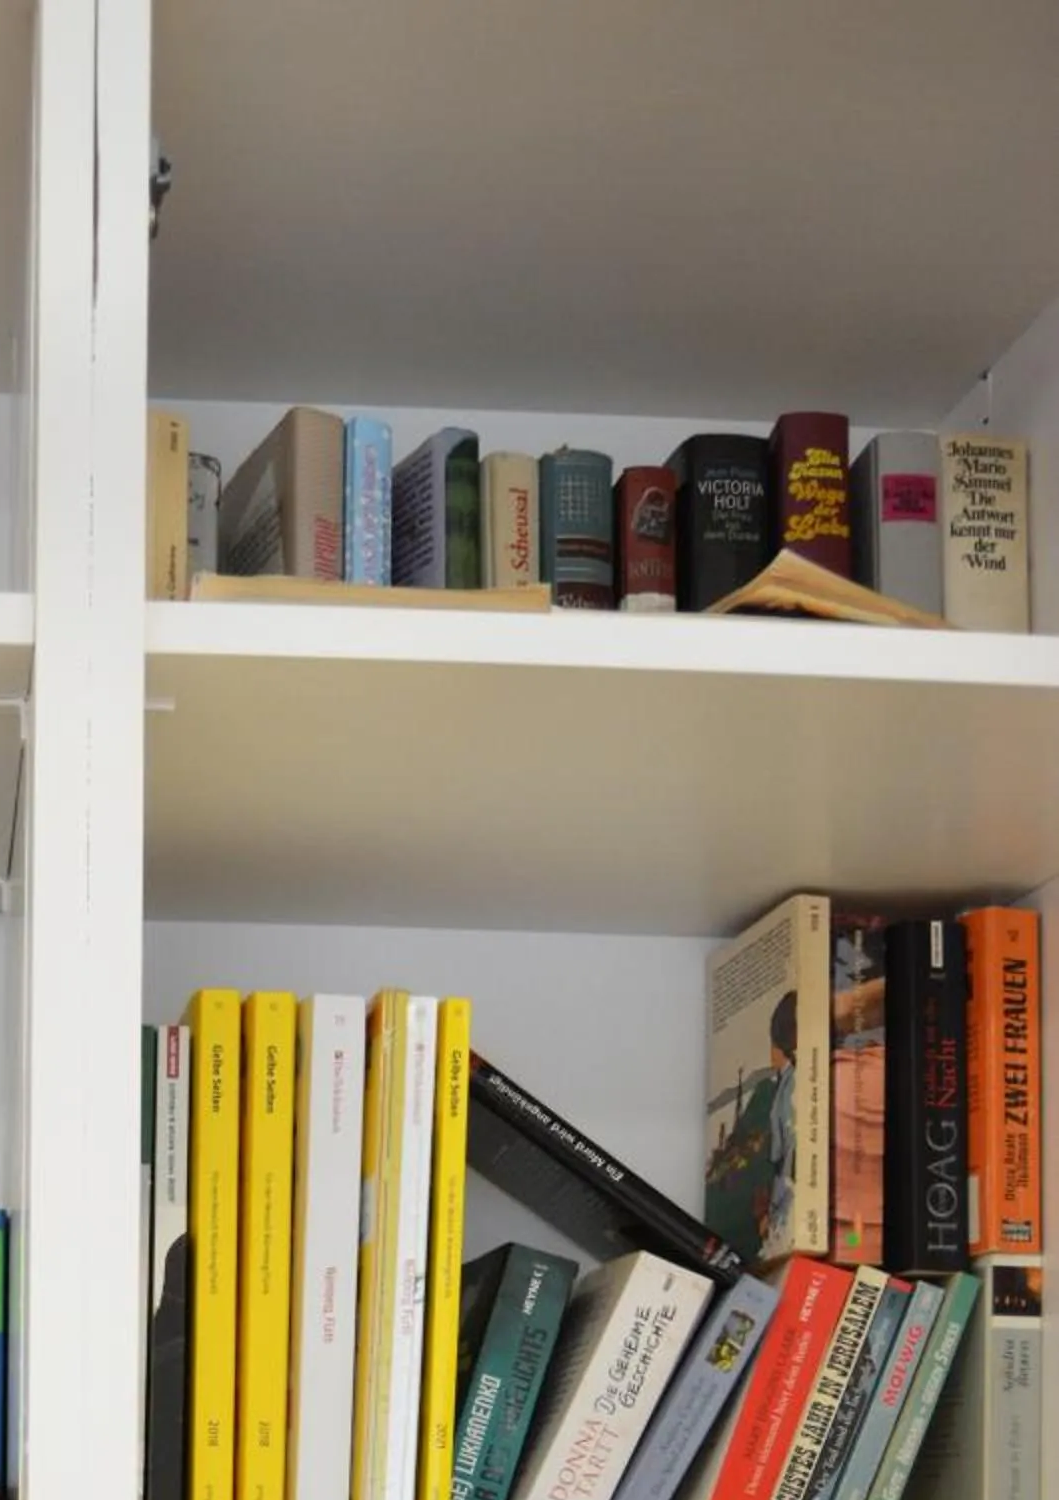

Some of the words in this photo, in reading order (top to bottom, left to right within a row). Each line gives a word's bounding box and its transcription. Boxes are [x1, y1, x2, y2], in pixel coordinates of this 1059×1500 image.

[946, 442, 1015, 460] Johannes
[960, 458, 1007, 476] Mario
[697, 480, 764, 498] VICTORIA
[952, 475, 1013, 493] Simmel
[967, 492, 997, 507] Die
[713, 495, 751, 511] HOLT
[959, 508, 1016, 524] Antwort
[949, 524, 991, 539] kennt
[994, 526, 1017, 540] nur
[973, 539, 997, 555] der
[960, 554, 1007, 572] Wind
[1004, 958, 1028, 1055] FRAUEN
[211, 1044, 223, 1076] Gelbe
[265, 1046, 277, 1077] Gelbe
[450, 1049, 462, 1082] Gelbe
[938, 1039, 958, 1109] Nacht
[211, 1079, 223, 1112] Seiten
[265, 1080, 276, 1114] Seiten
[449, 1085, 461, 1118] Seiten
[489, 1073, 552, 1124] angekündigt
[1004, 1062, 1028, 1126] ZWEI
[551, 1122, 576, 1144] wird
[575, 1141, 606, 1168] Mord
[606, 1164, 625, 1182] Ein
[925, 1120, 959, 1252] HOAG
[523, 1275, 542, 1315] HEYNE
[607, 1306, 652, 1382] GEHEIME
[618, 1303, 678, 1410] GESCHICHTE
[801, 1400, 834, 1448] JAHR
[821, 1376, 842, 1405] IN
[833, 1281, 882, 1382] JERUSALEM
[207, 1420, 219, 1447] 2018
[460, 1373, 501, 1474] LUKIANENKO
[574, 1427, 620, 1498] TARTT
